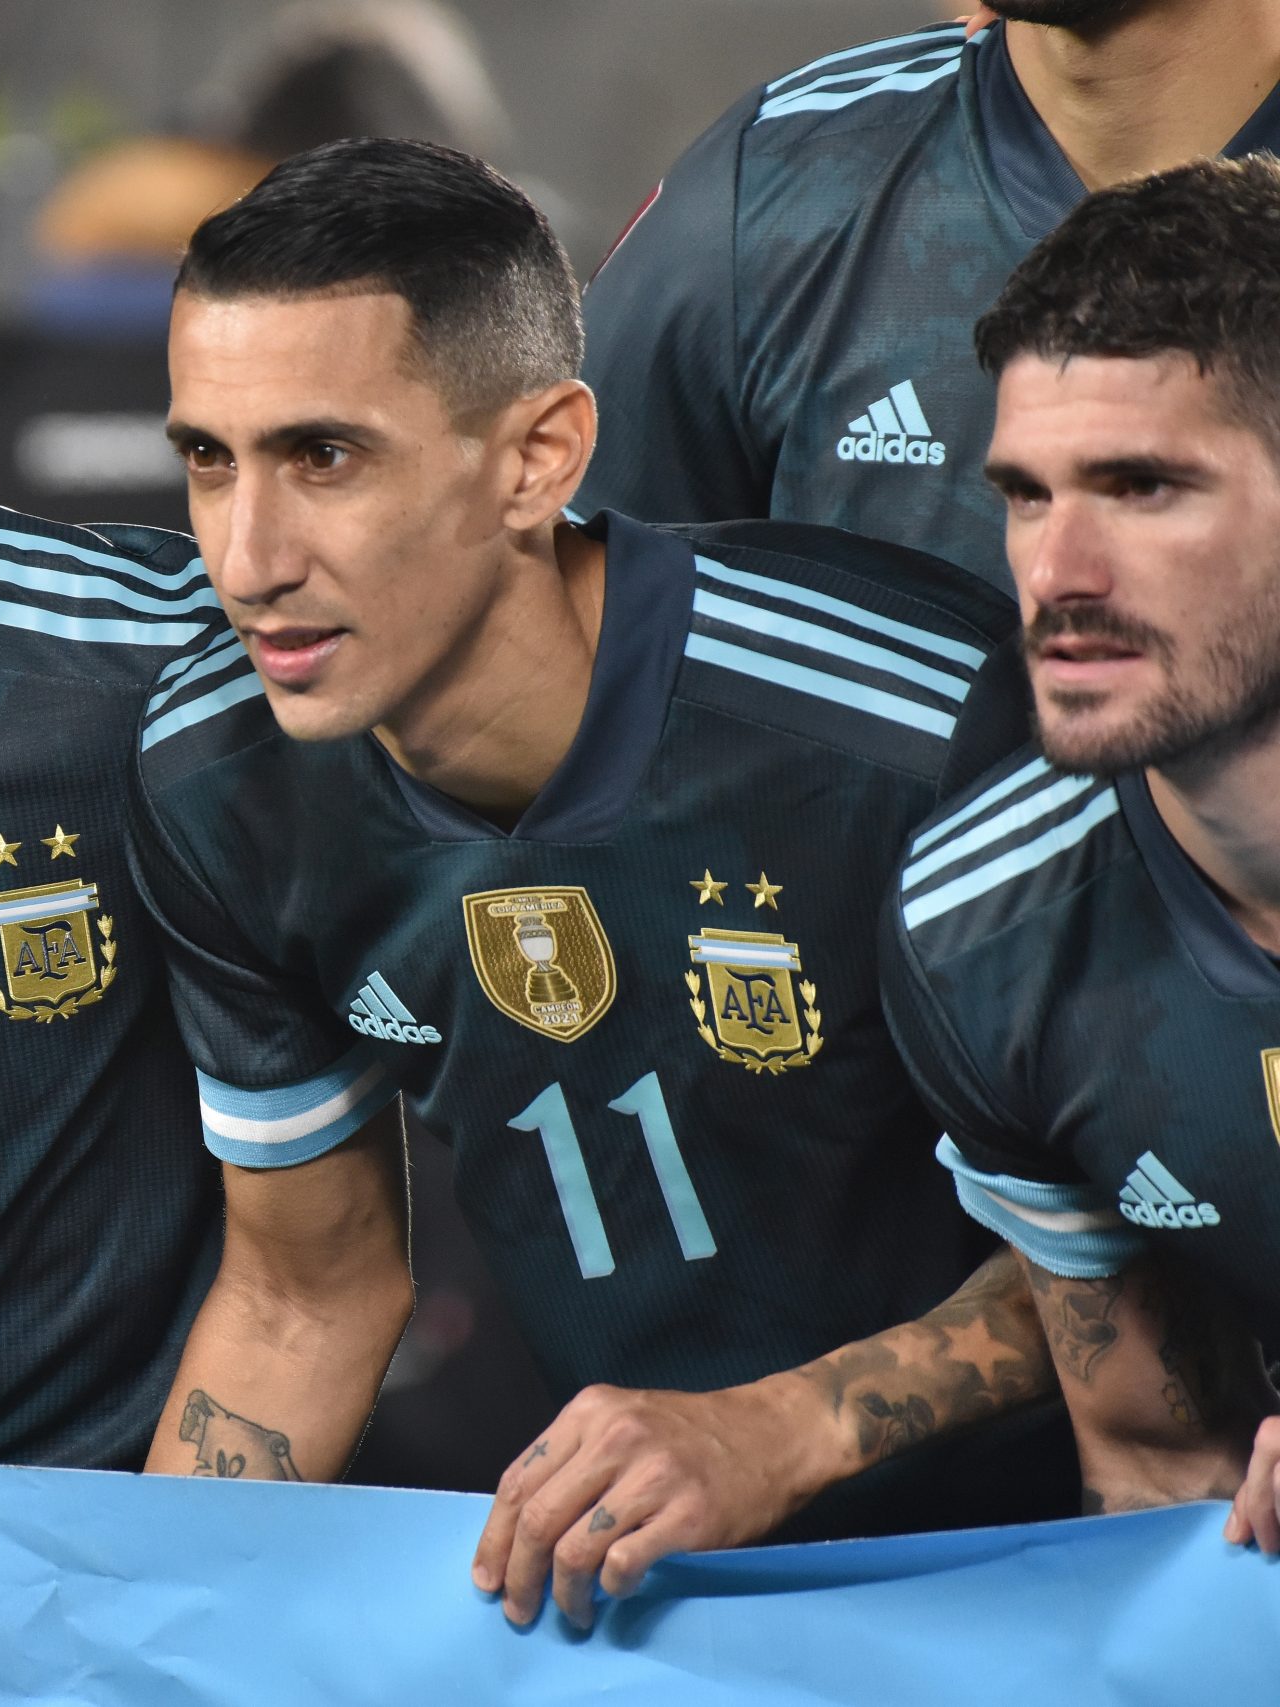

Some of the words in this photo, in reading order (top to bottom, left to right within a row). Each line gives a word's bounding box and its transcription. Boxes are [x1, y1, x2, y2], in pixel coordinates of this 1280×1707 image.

[836, 430, 946, 466] adidas
[13, 920, 87, 980] AFA
[542, 1012, 580, 1025] 2021
[721, 967, 791, 1035] AFA
[348, 1012, 443, 1045] adidas
[506, 1070, 718, 1280] 11
[1119, 1200, 1221, 1230] adidas
